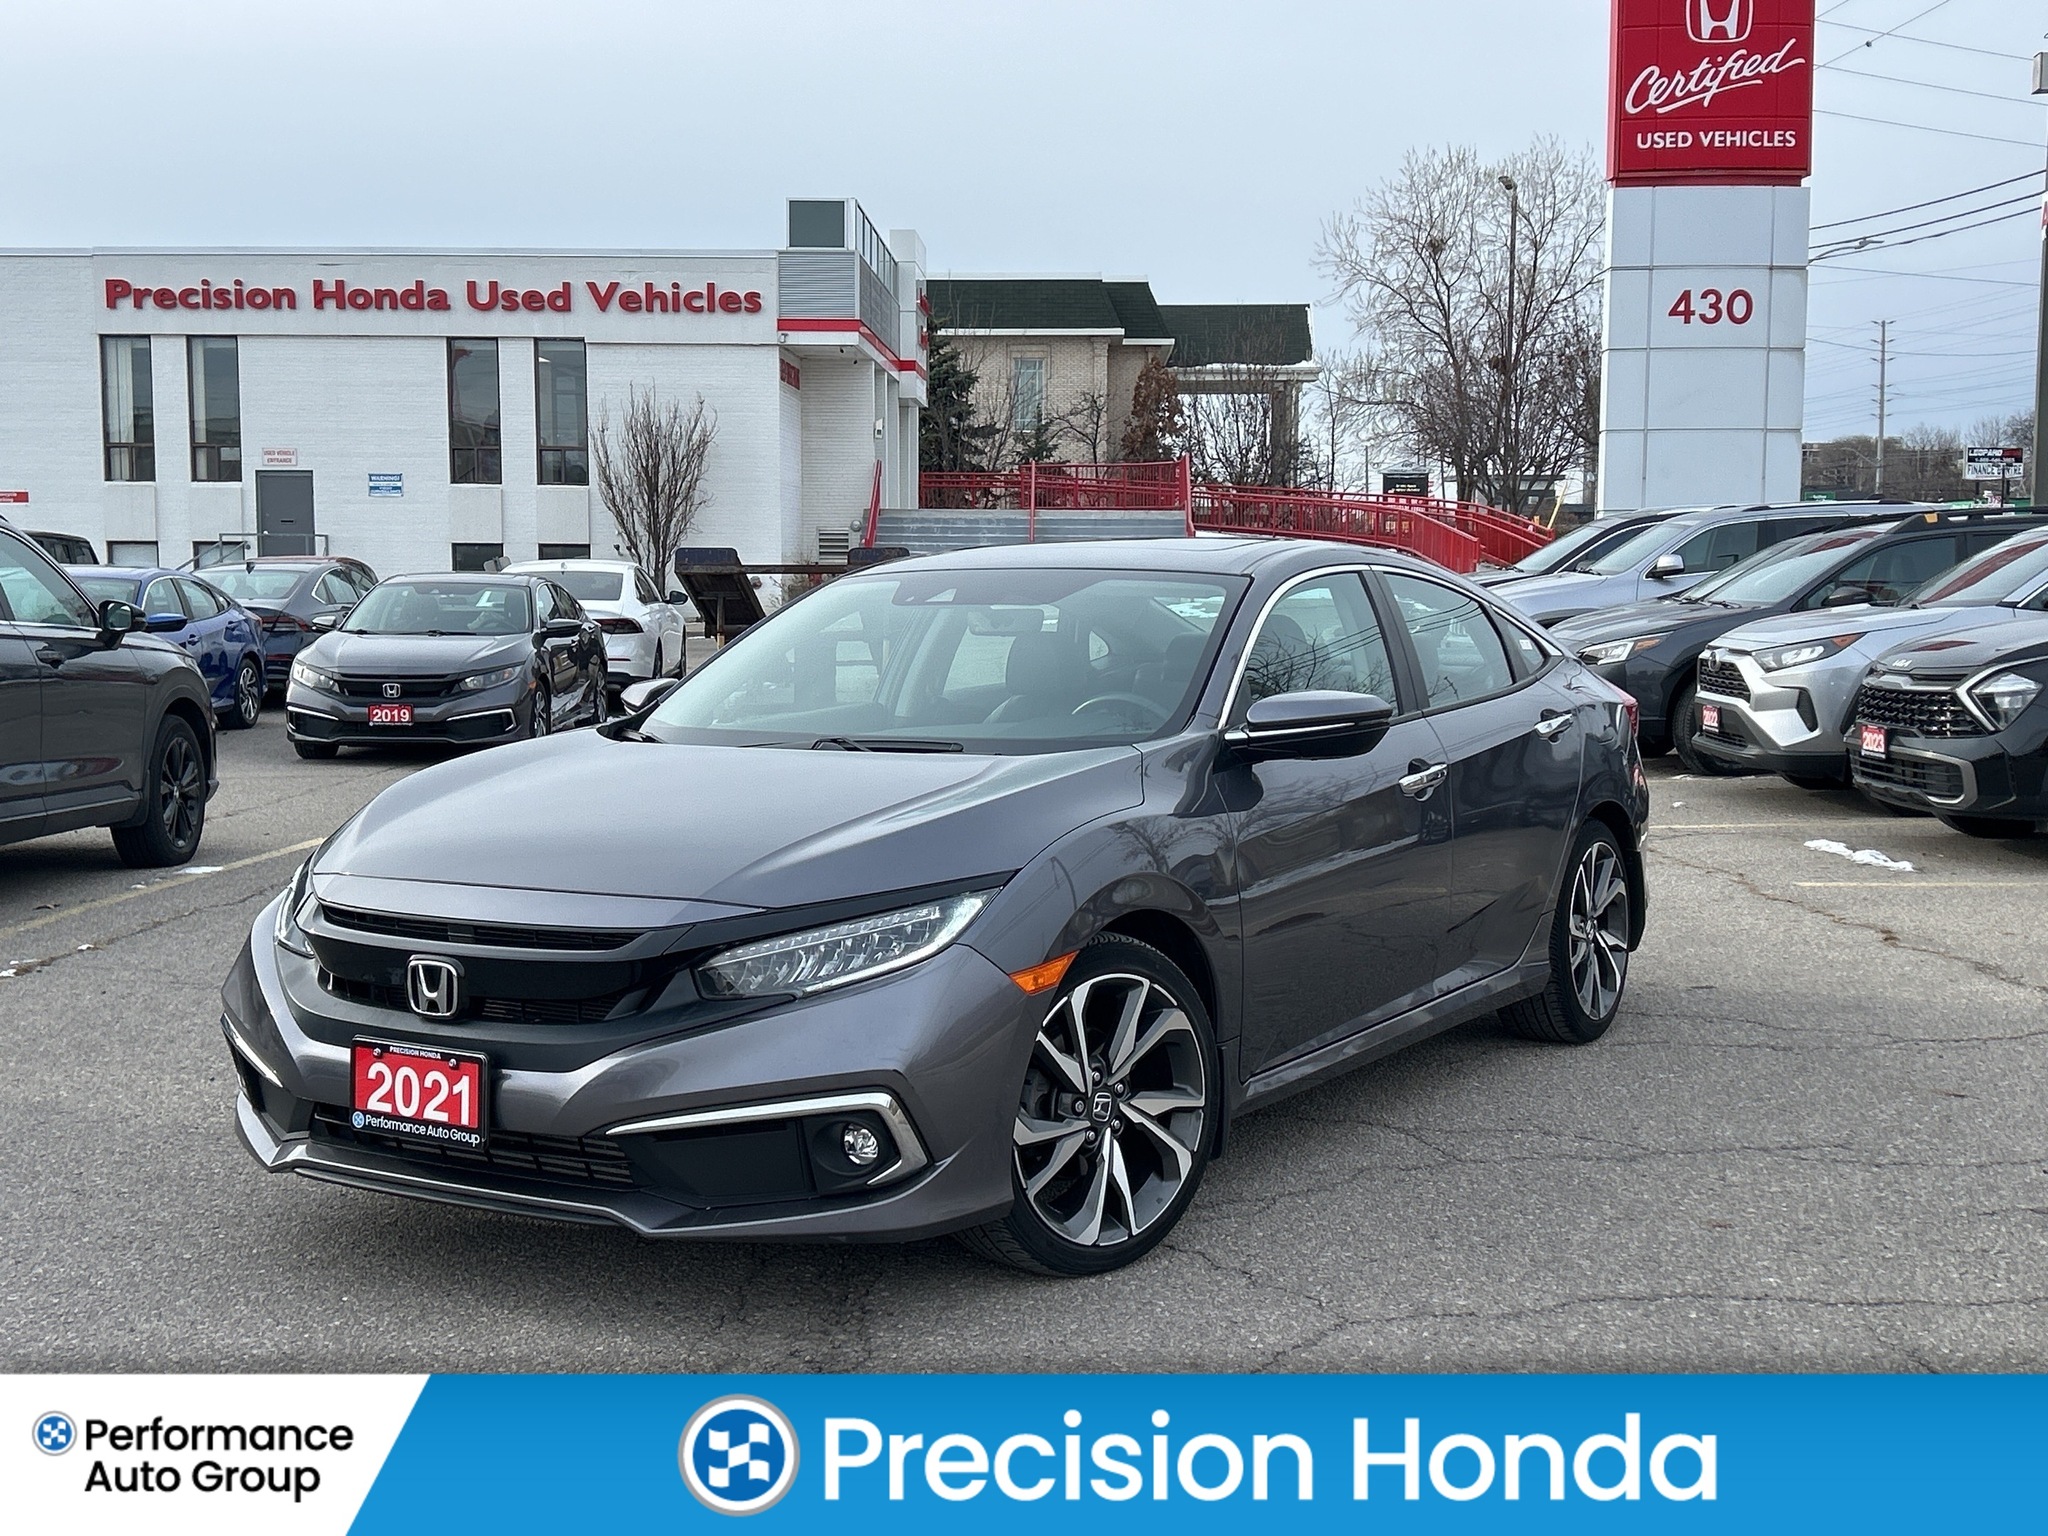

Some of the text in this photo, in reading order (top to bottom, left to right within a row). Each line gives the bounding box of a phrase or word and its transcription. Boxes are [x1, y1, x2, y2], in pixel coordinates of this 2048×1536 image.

[1625, 37, 1806, 114] Certified
[1636, 130, 1796, 149] USED VEHICLES
[105, 278, 763, 313] Precision Honda Used Vehicles
[1668, 288, 1753, 325] 430
[372, 709, 410, 722] 2019
[1862, 731, 1885, 753] 2023
[389, 1046, 441, 1060] PRECISION HONDA
[366, 1062, 470, 1126] 2021
[365, 1114, 480, 1147] Performance Auto Group
